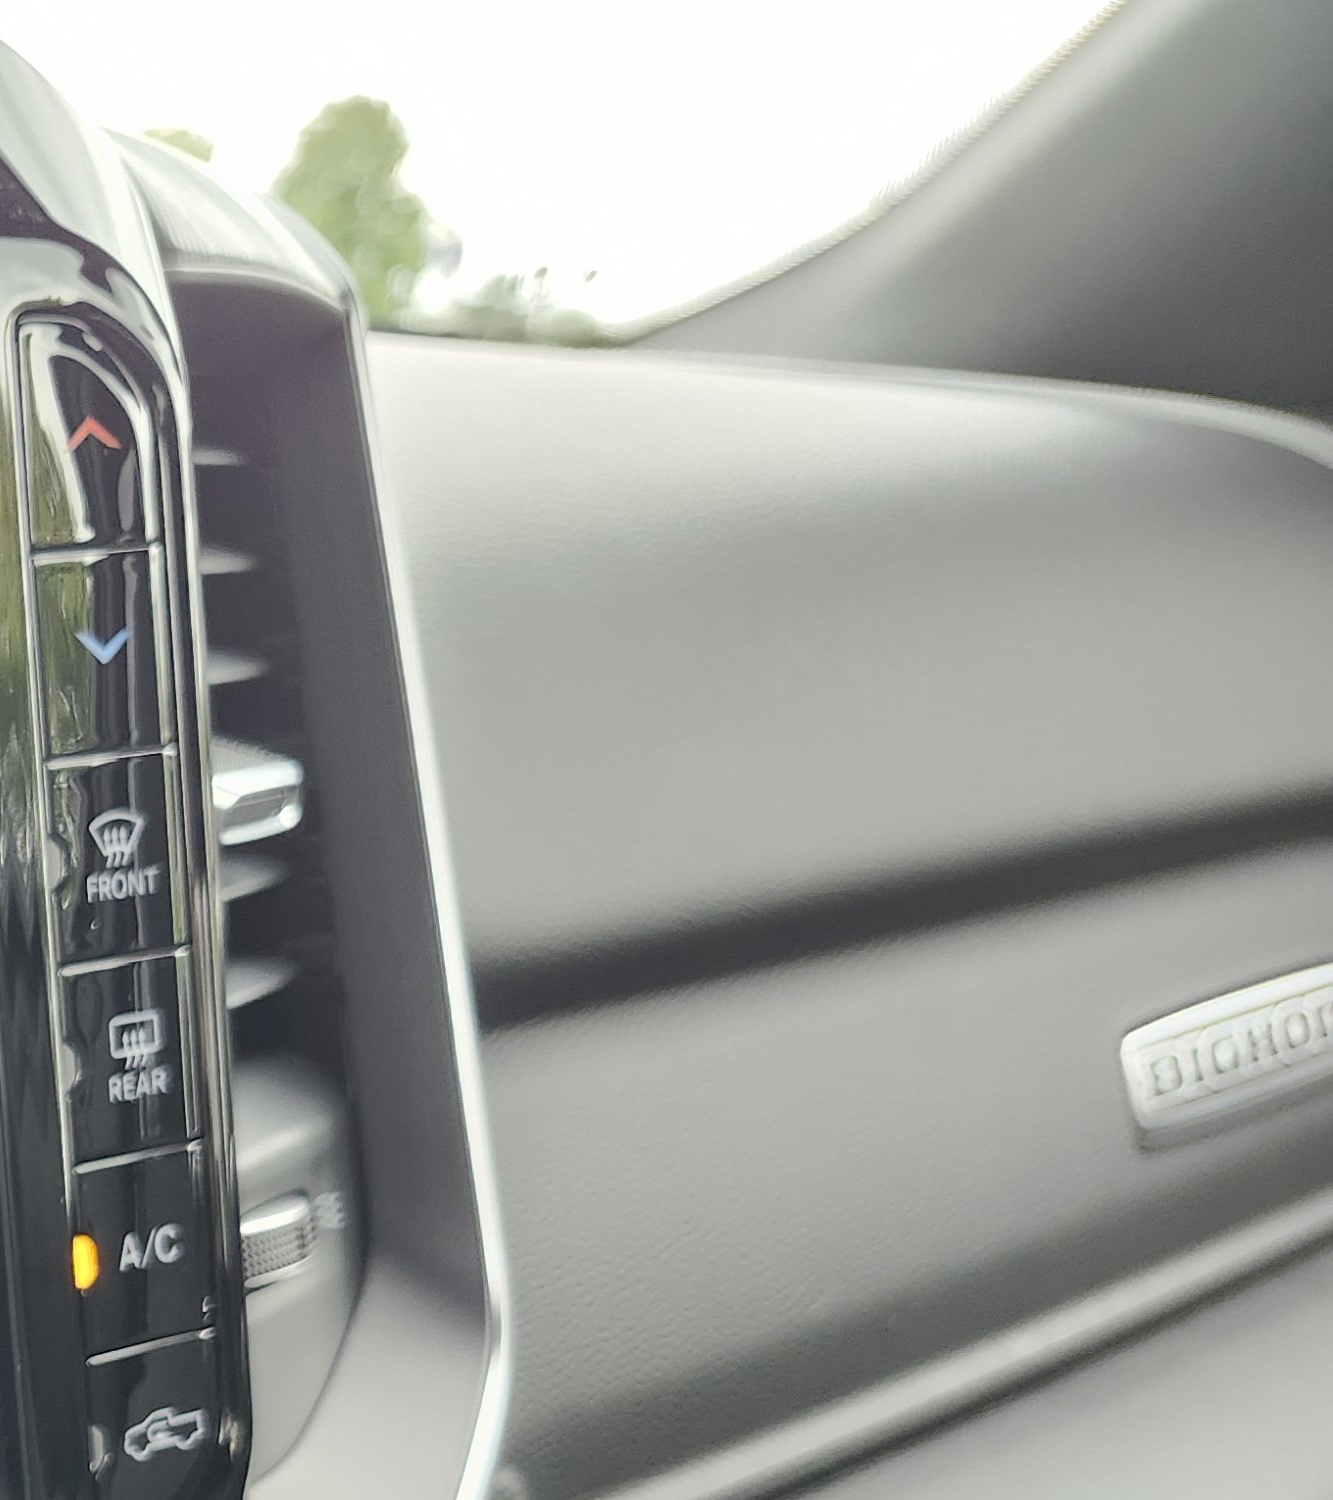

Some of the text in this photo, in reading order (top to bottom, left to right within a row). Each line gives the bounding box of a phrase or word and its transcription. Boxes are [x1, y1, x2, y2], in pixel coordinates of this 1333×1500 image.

[86, 864, 161, 903] FRONT
[108, 1064, 171, 1103] REAR
[119, 1222, 184, 1273] A/C
